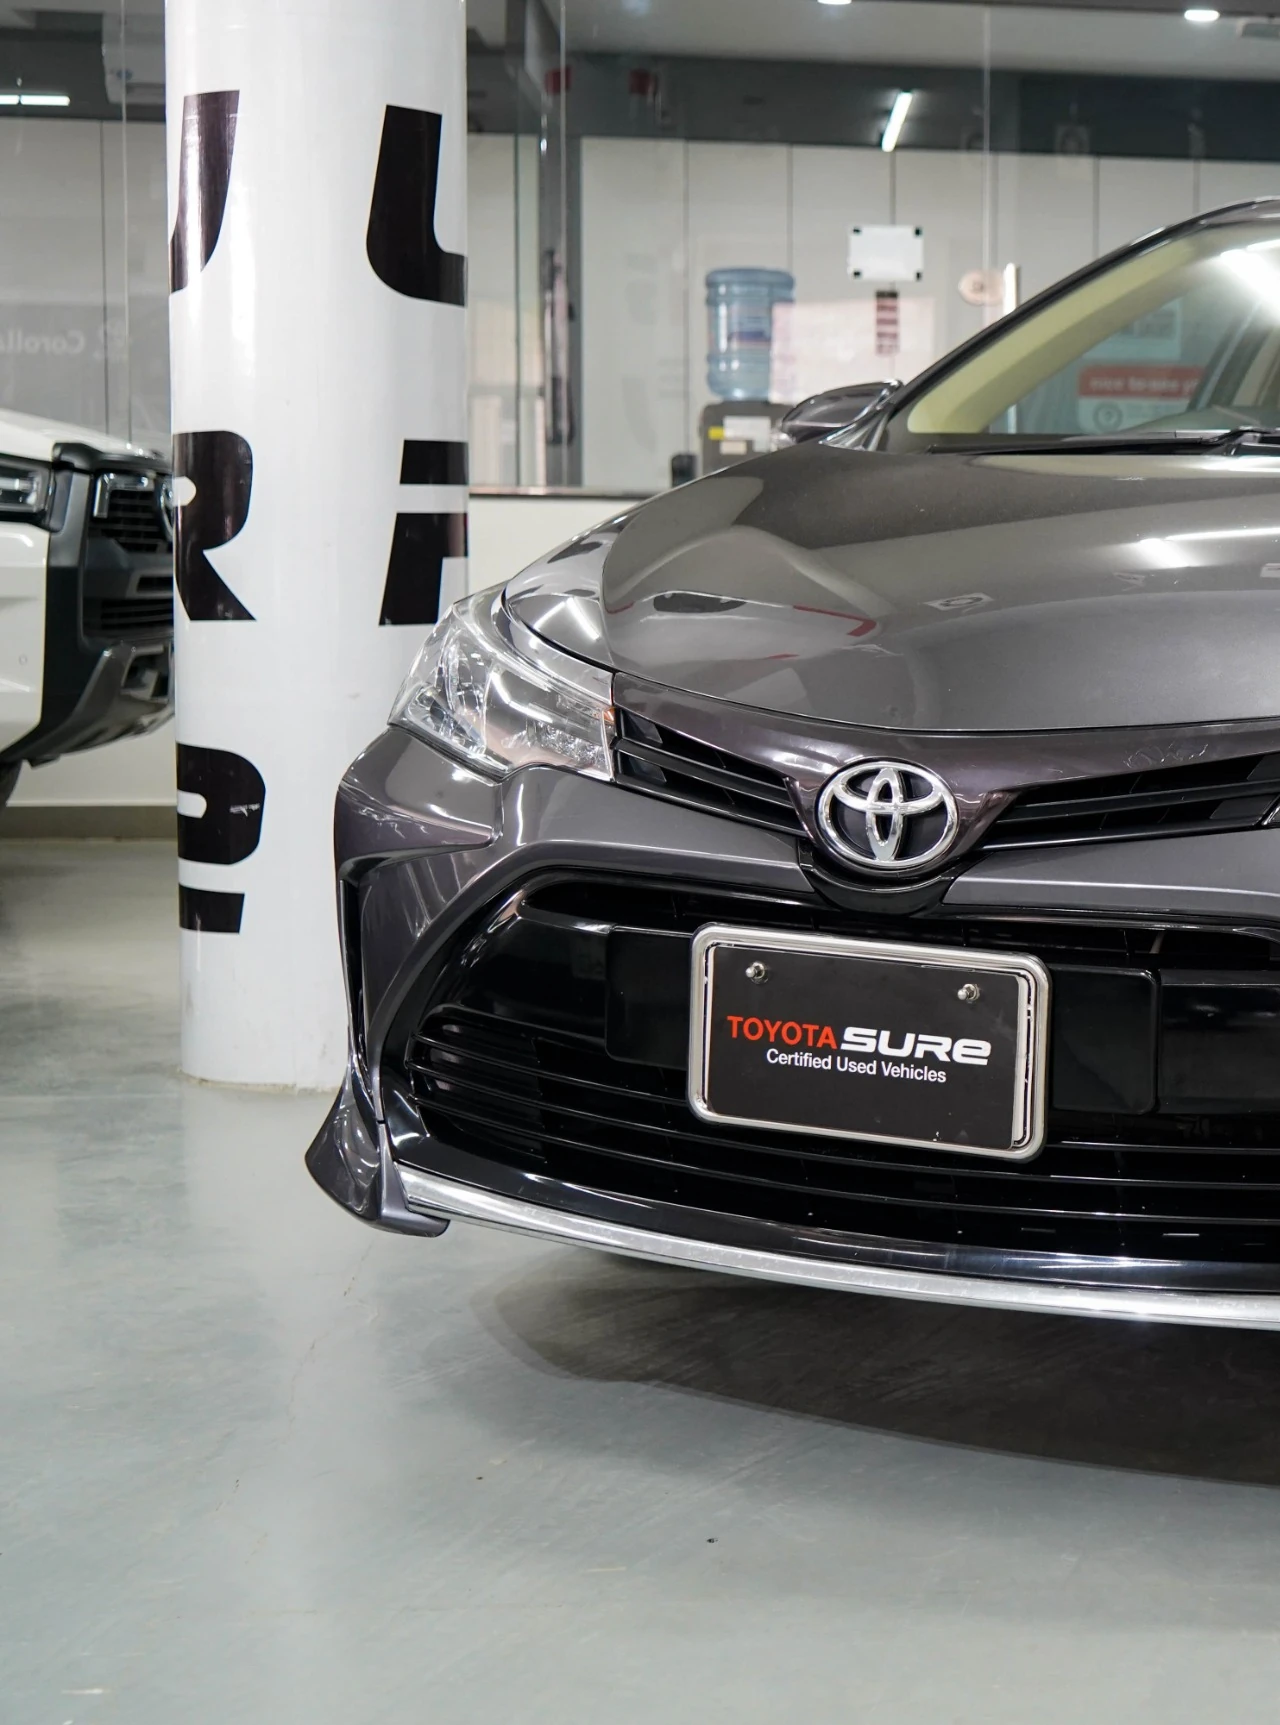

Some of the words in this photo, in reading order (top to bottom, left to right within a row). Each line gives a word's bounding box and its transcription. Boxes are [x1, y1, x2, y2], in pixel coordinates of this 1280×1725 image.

[726, 1014, 838, 1050] TOYOTA
[766, 1047, 832, 1070] Certified
[836, 1055, 877, 1076] Used
[881, 1060, 947, 1083] Vehicles
